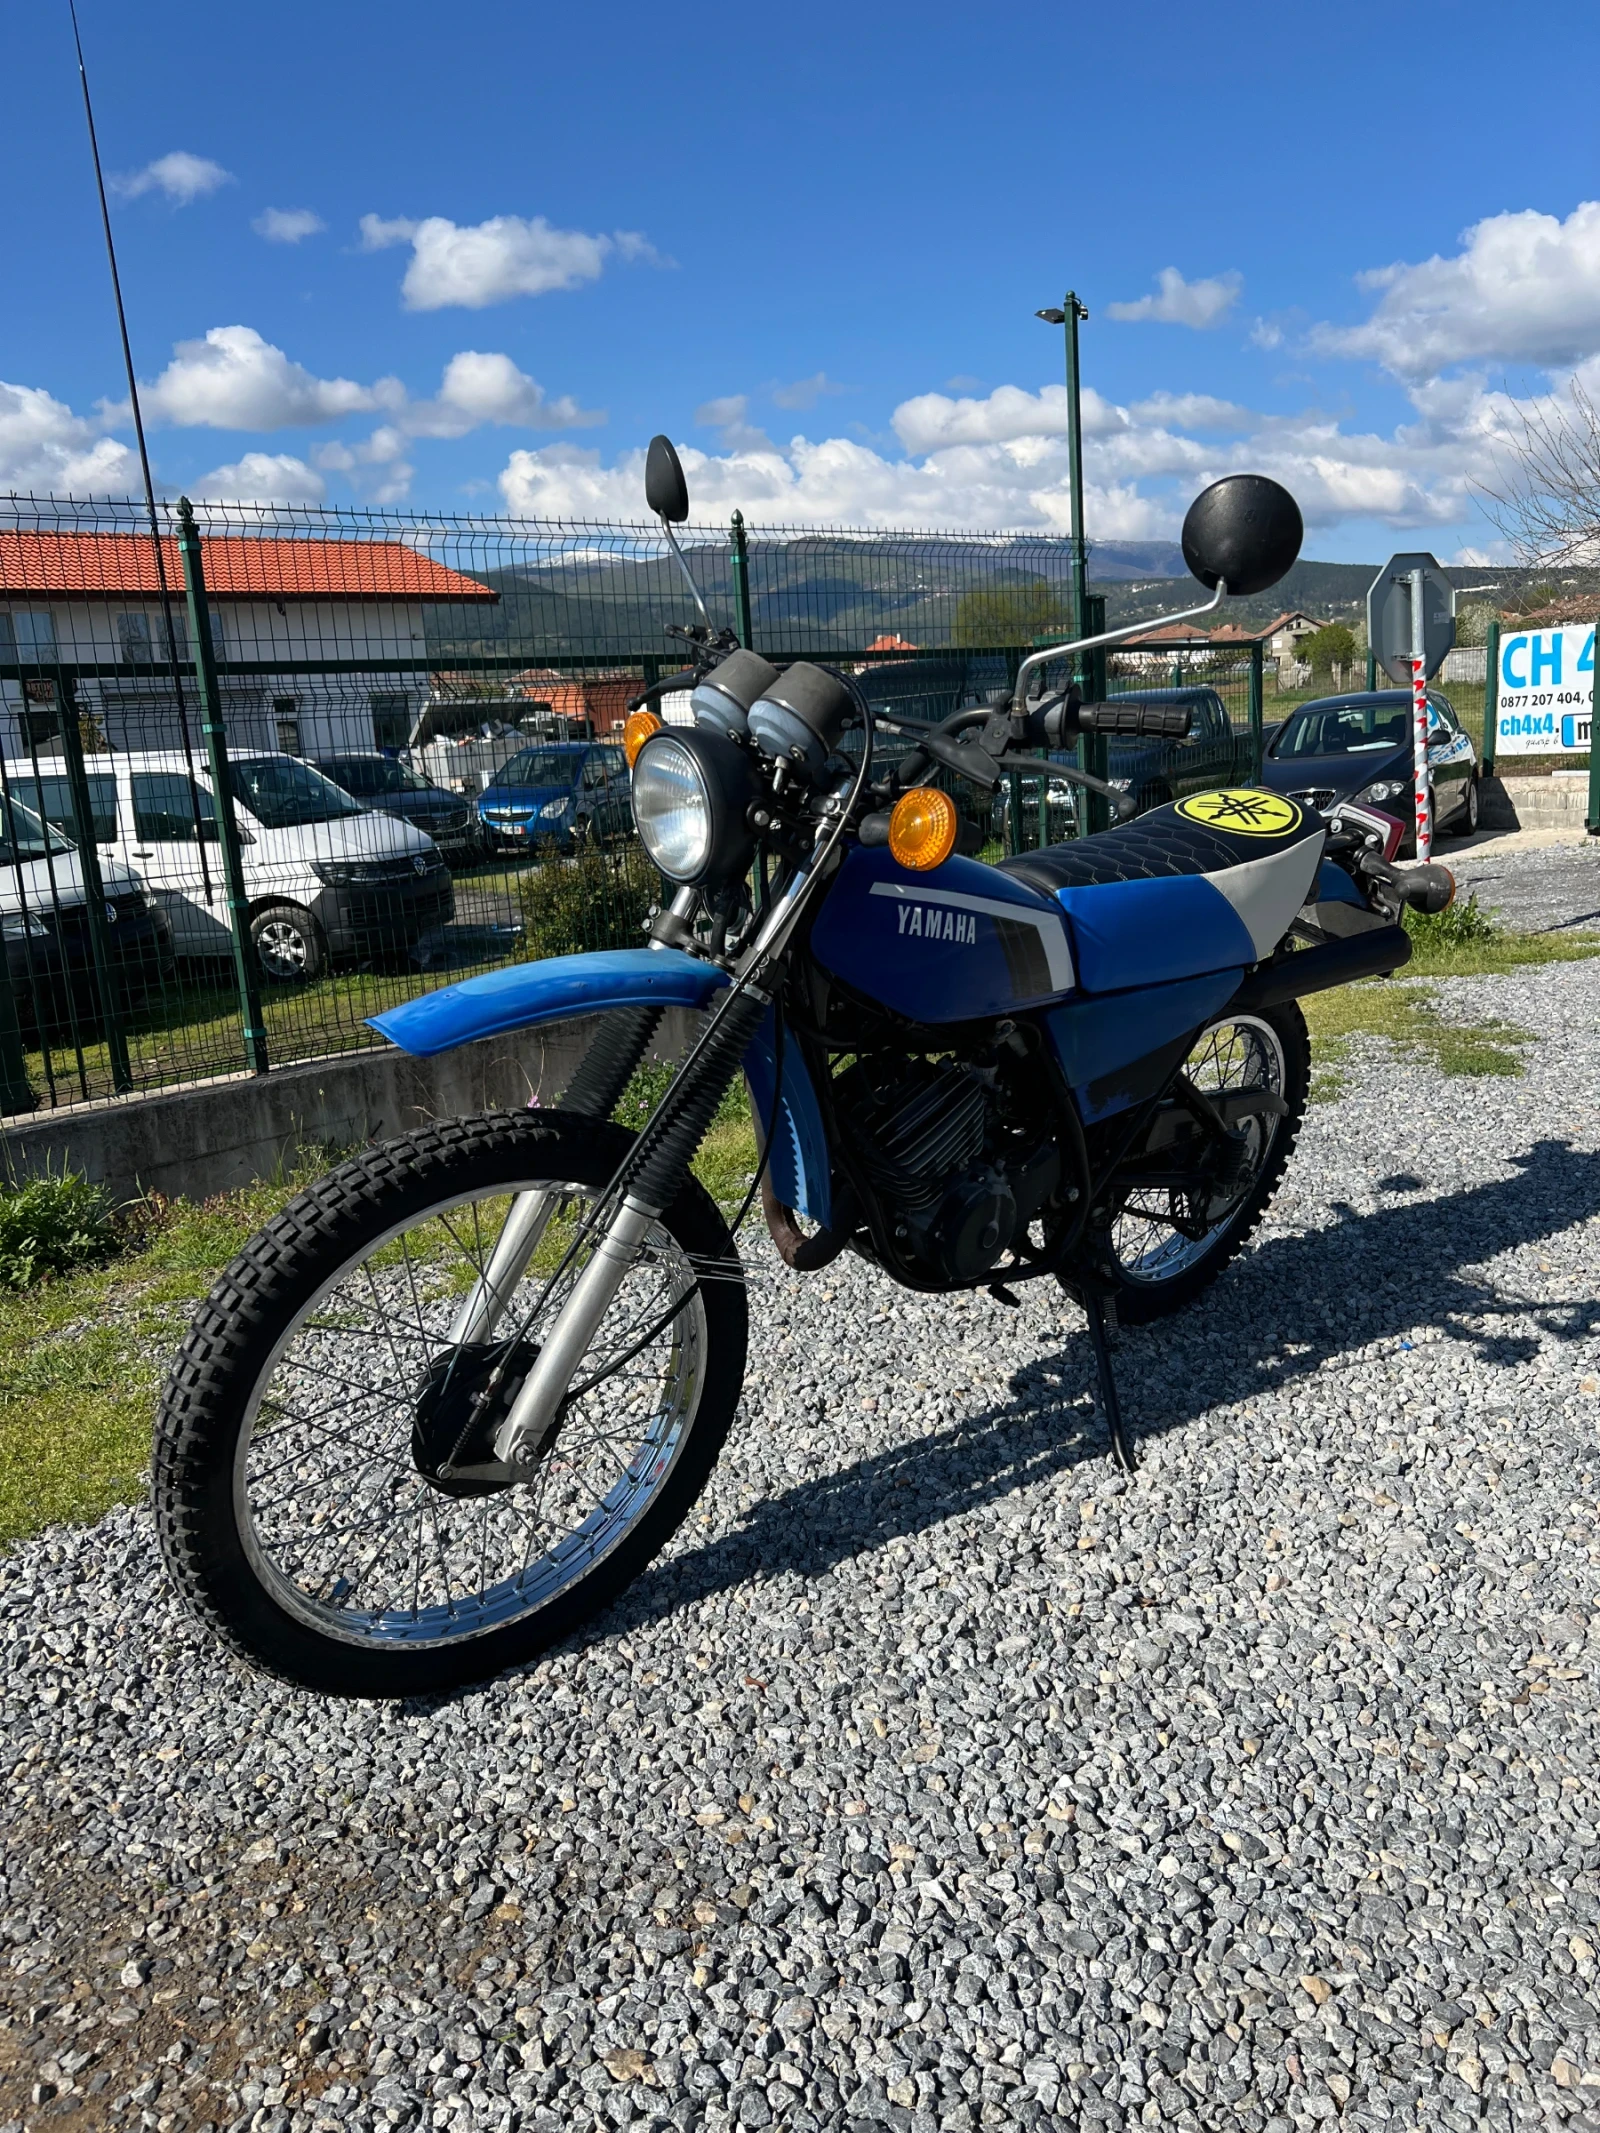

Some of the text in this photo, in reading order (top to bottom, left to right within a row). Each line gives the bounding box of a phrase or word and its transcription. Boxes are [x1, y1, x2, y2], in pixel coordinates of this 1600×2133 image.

[1502, 633, 1563, 689] CH
[1501, 695, 1528, 708] 0877
[1531, 693, 1553, 707] 207
[1557, 691, 1585, 705] 404,
[898, 905, 976, 944] YAMAHA
